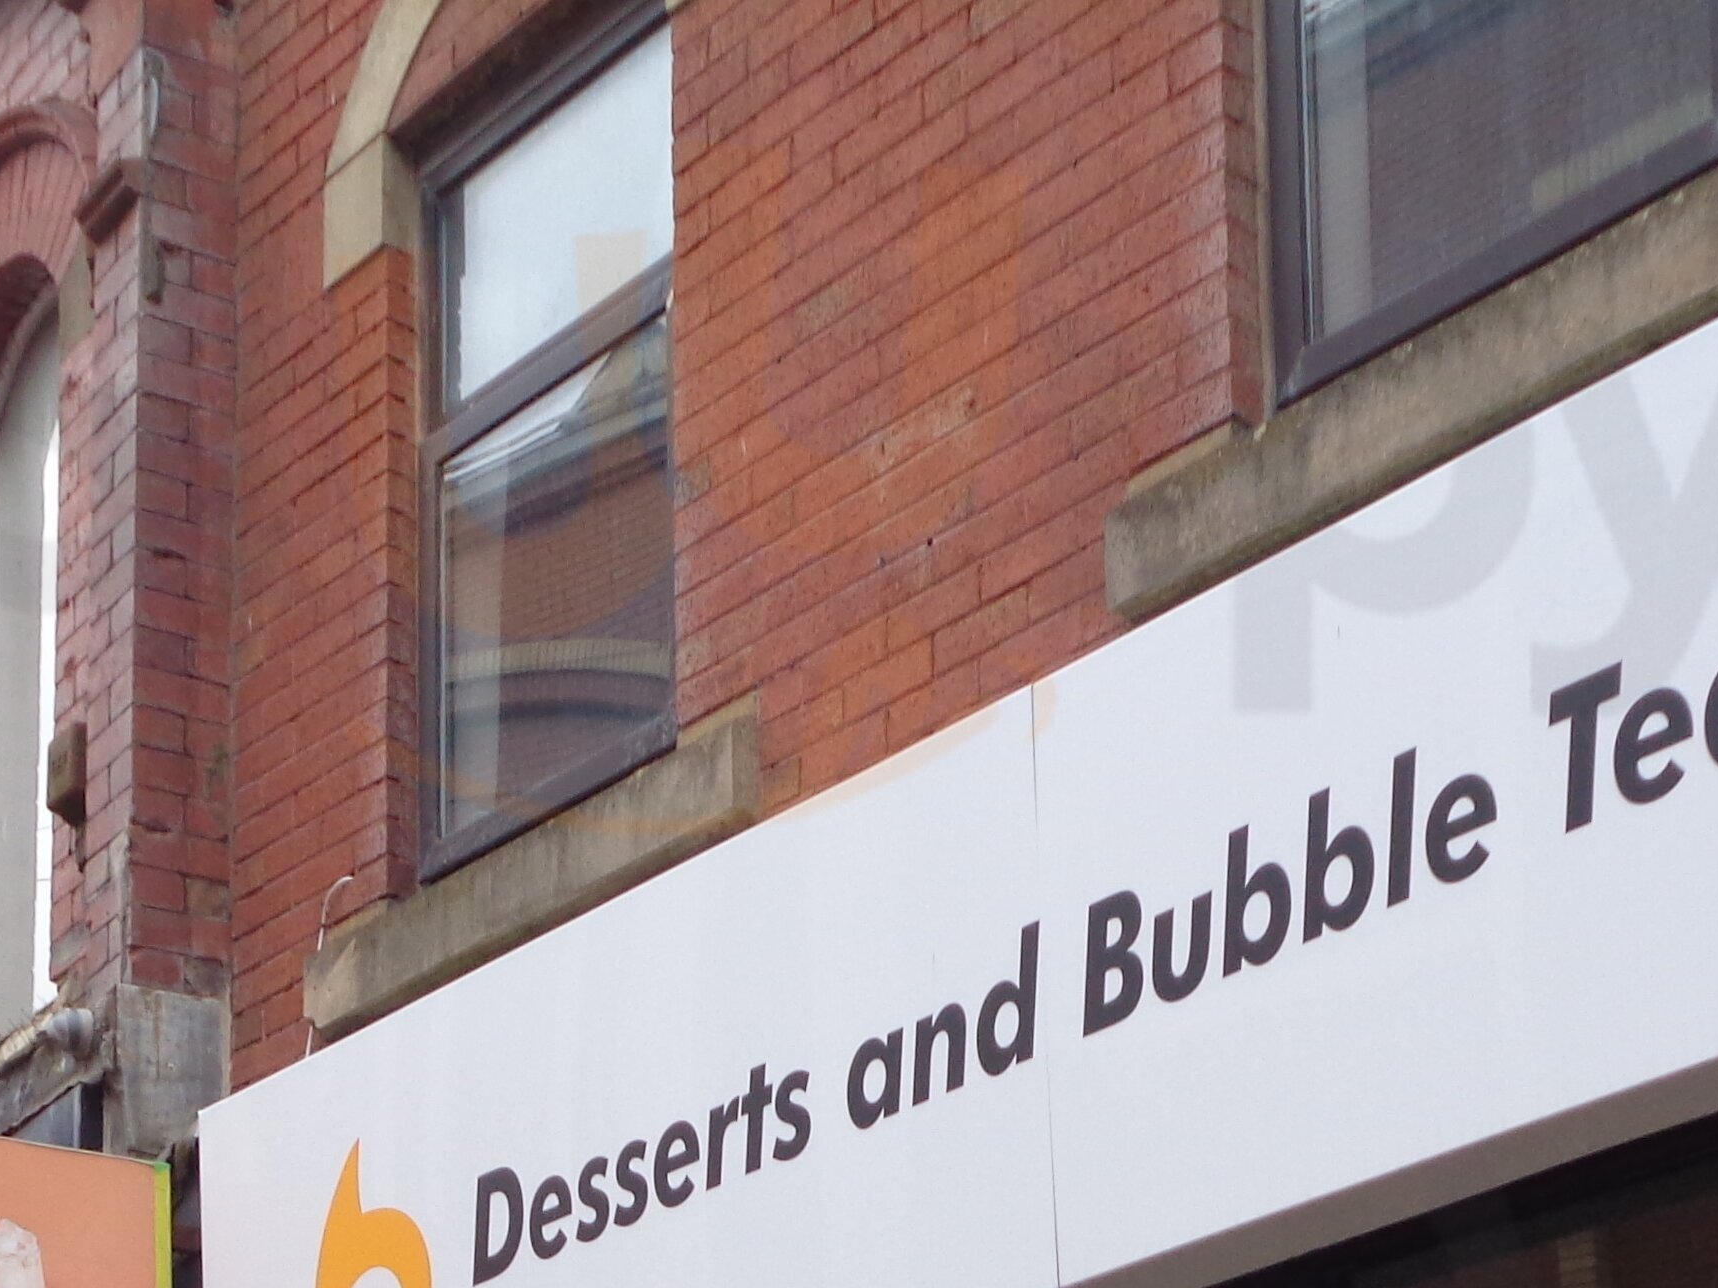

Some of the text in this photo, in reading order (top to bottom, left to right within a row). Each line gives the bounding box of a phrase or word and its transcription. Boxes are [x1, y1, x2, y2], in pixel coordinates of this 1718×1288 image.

[473, 1059, 812, 1285] Desserts
[847, 925, 1041, 1128] and
[1081, 747, 1496, 1038] Bubble
